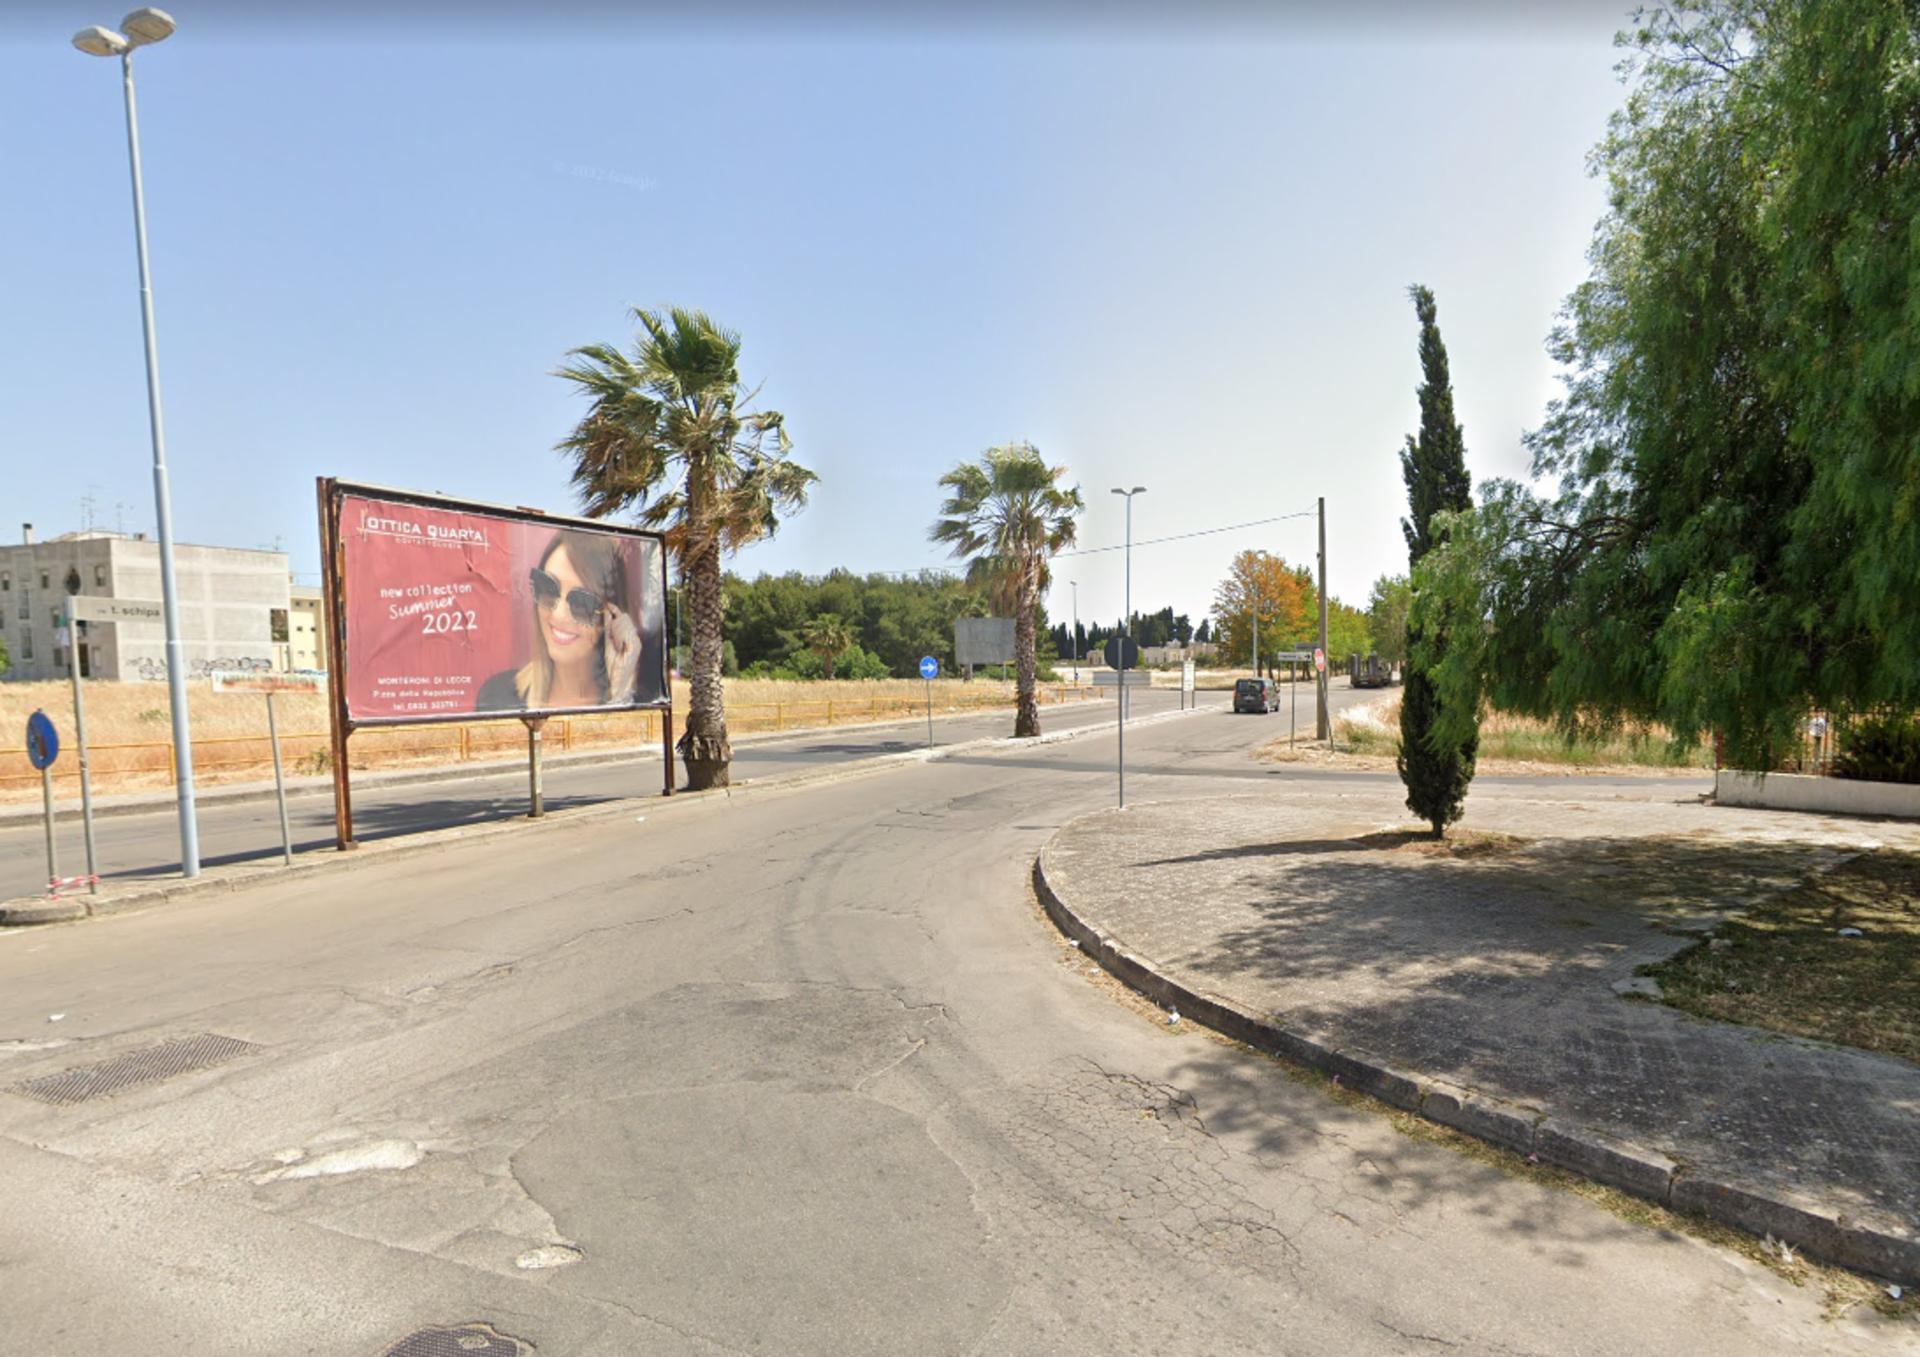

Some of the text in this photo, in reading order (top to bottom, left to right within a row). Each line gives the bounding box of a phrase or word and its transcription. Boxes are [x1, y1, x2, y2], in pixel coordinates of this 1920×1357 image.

[367, 517, 484, 541] OTTICA QUARTA
[380, 584, 472, 598] new collection
[122, 607, 160, 617] schipa
[389, 595, 455, 619] Summer
[422, 610, 478, 634] 2022
